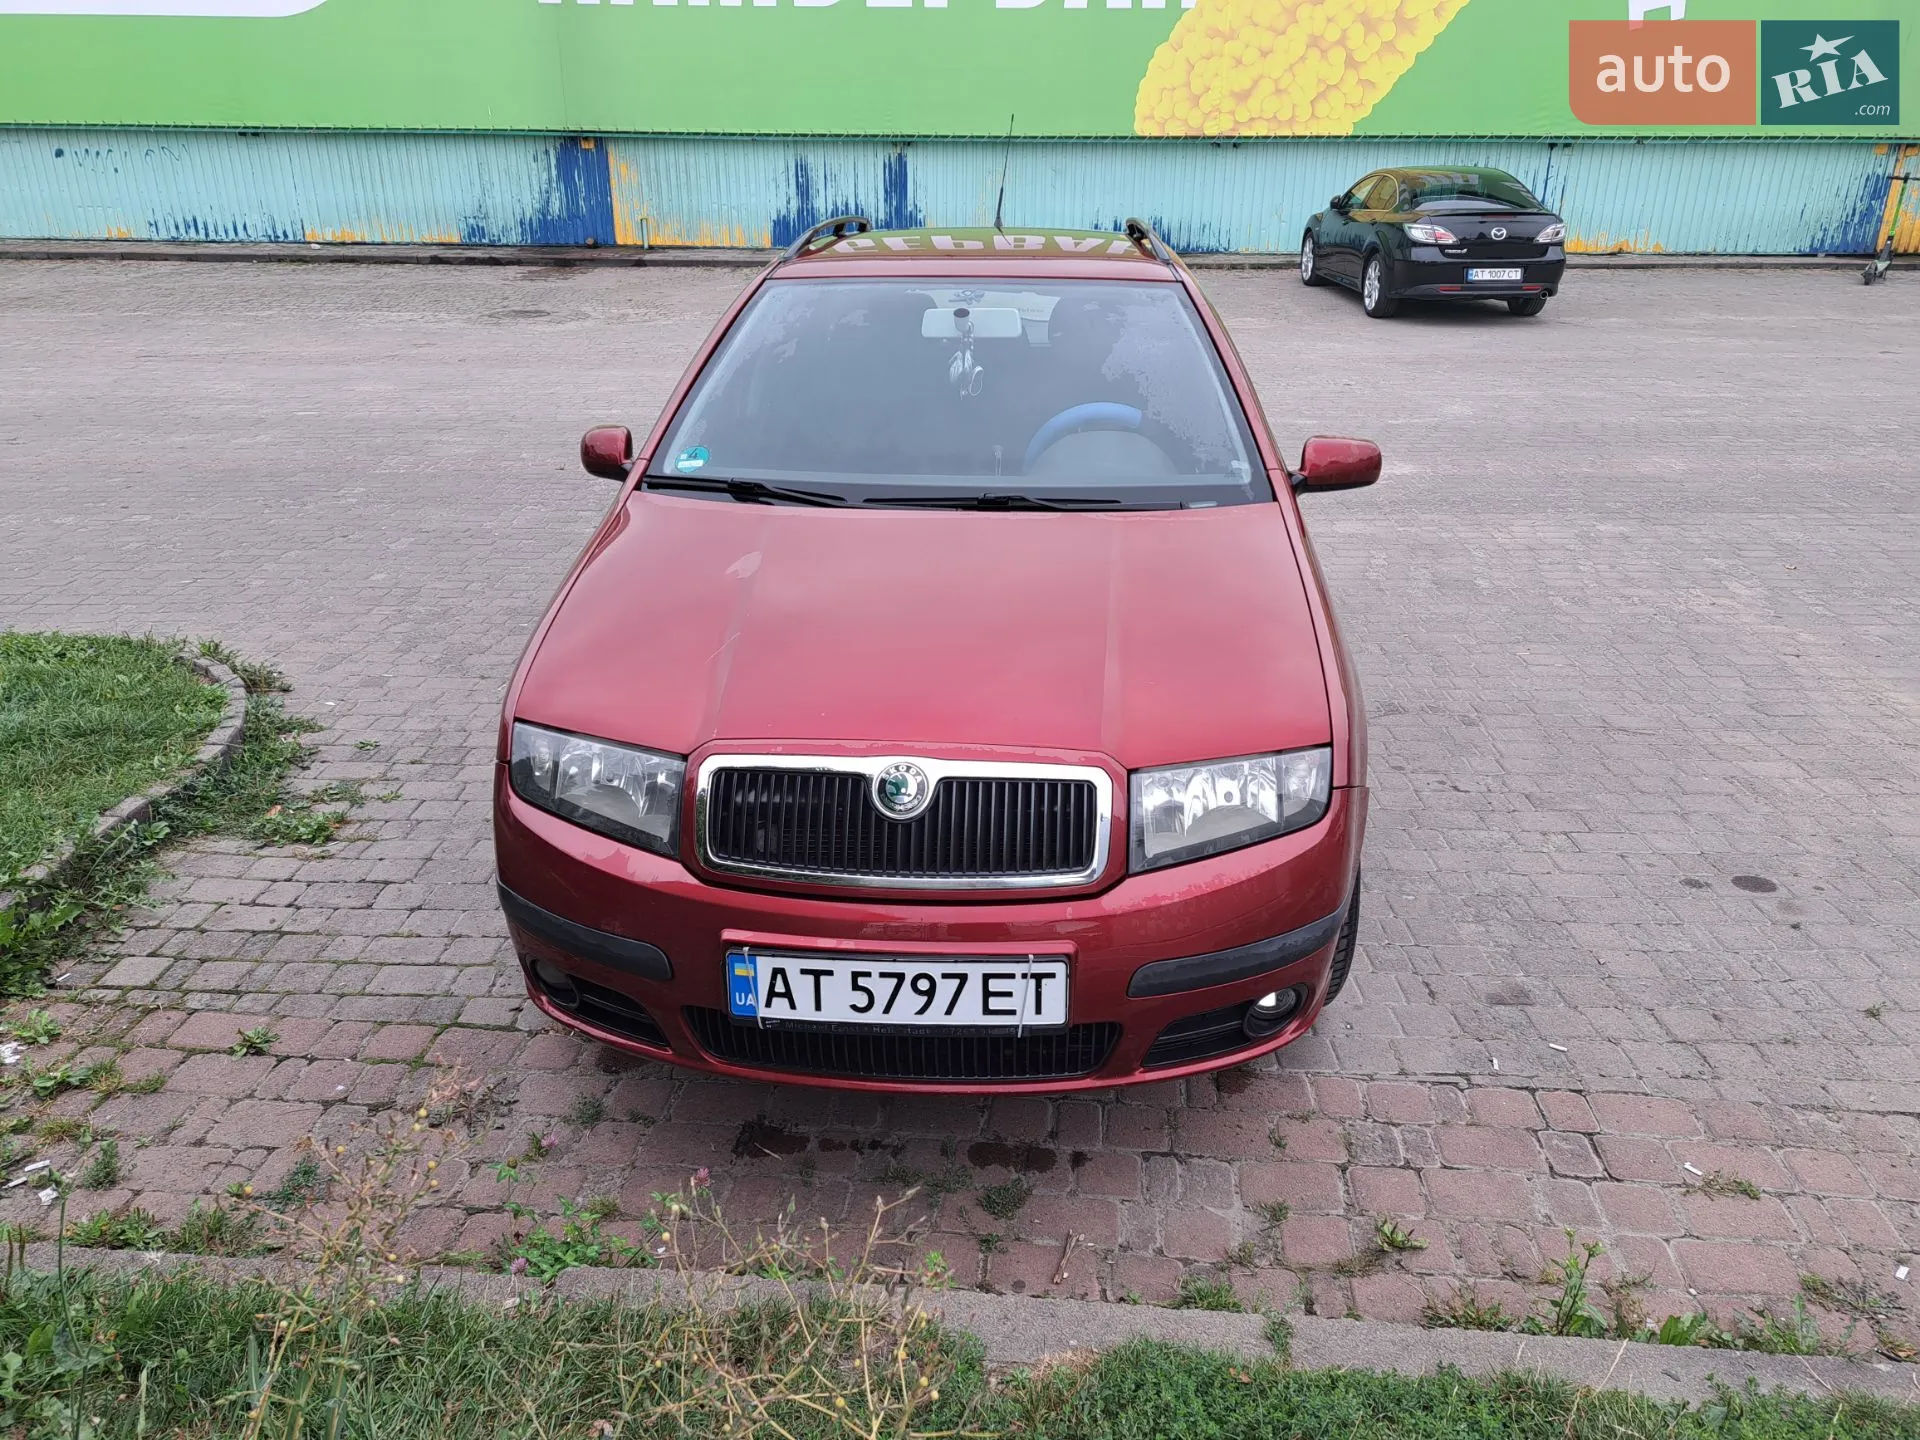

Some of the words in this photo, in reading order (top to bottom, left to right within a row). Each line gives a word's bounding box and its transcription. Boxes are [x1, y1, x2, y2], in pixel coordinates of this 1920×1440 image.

[1474, 270, 1486, 279] AT
[1488, 270, 1506, 279] 1007
[1507, 270, 1519, 279] CT
[688, 448, 698, 459] 4
[764, 967, 834, 1012] AT
[848, 970, 969, 1016] 5797
[982, 972, 1056, 1016] ET
[735, 992, 756, 1006] UA
